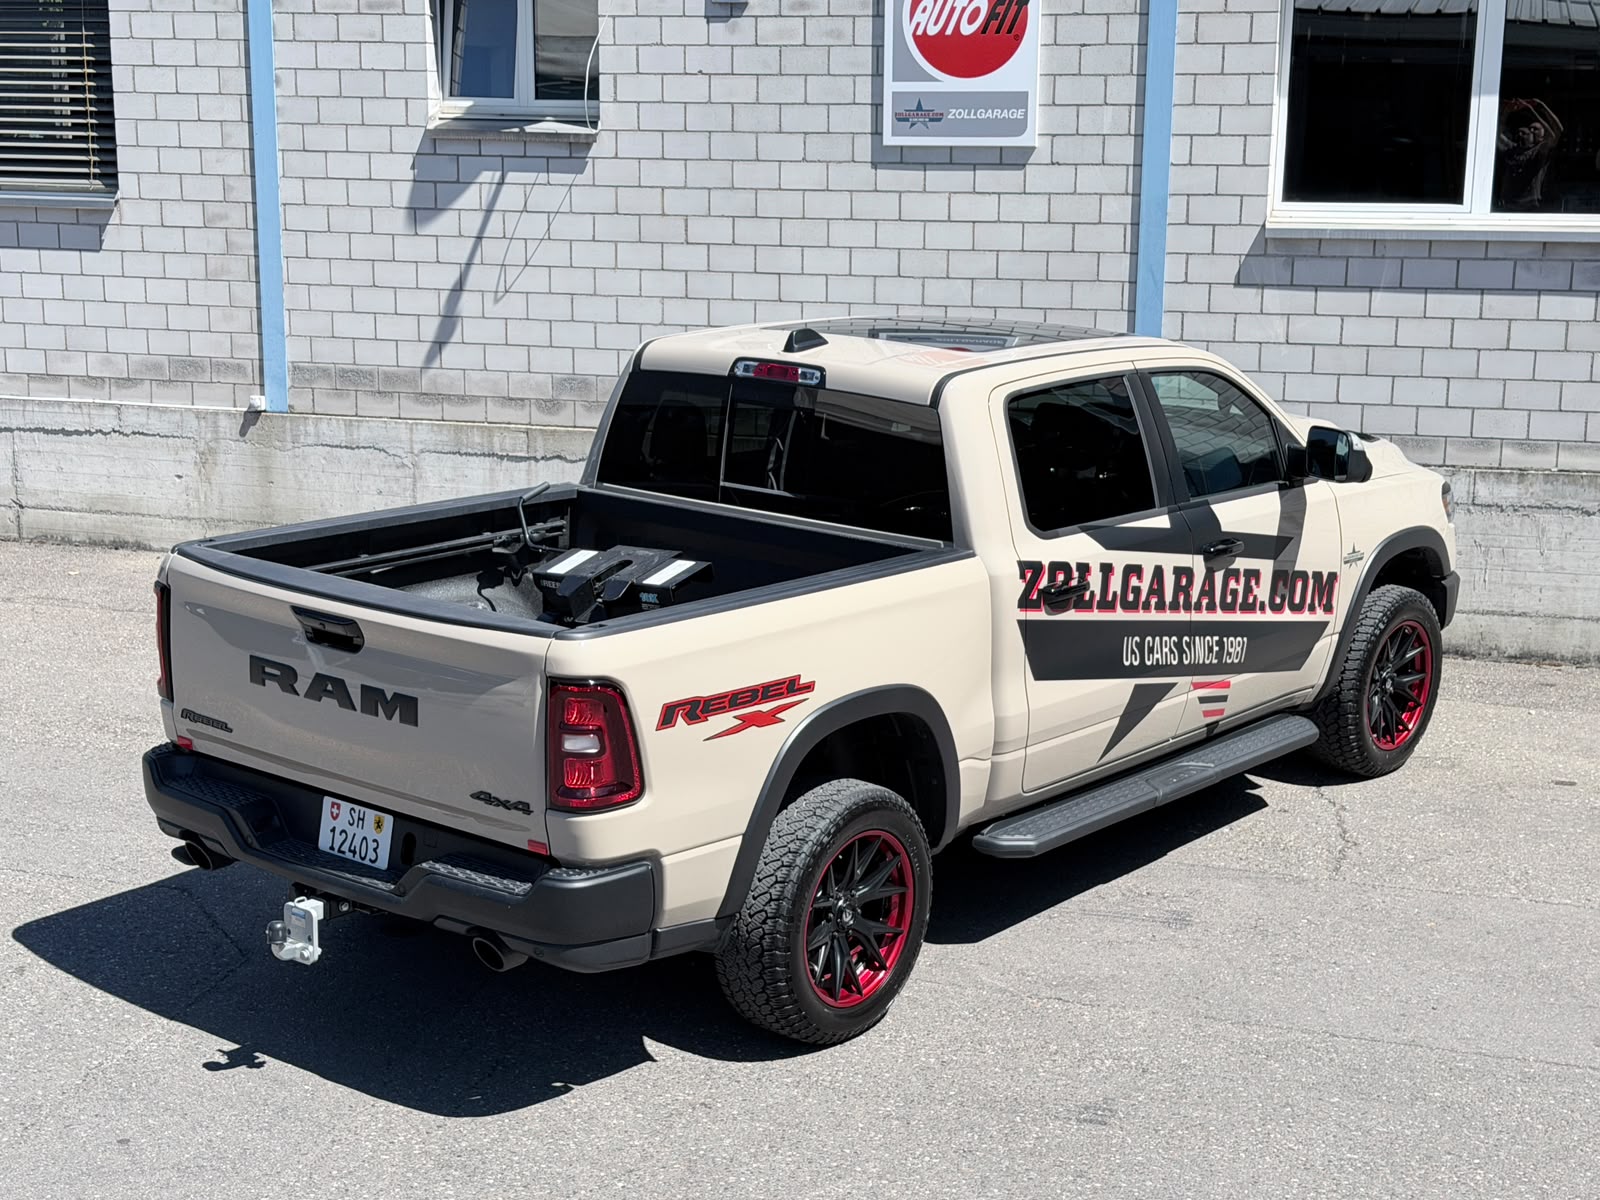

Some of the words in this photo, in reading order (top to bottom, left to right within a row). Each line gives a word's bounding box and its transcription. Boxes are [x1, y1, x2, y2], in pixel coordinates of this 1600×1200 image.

[910, 0, 1031, 36] AUTOFIT
[947, 108, 1026, 119] ZOLLGARAGE
[1123, 636, 1140, 666] US
[1144, 636, 1179, 666] CARS
[1182, 635, 1220, 665] SINCE
[1222, 636, 1248, 664] 1987
[248, 654, 419, 727] RAM
[655, 674, 816, 731] REBEL
[180, 707, 233, 733] REBEL
[347, 807, 367, 830] SH
[328, 826, 380, 865] 12403
